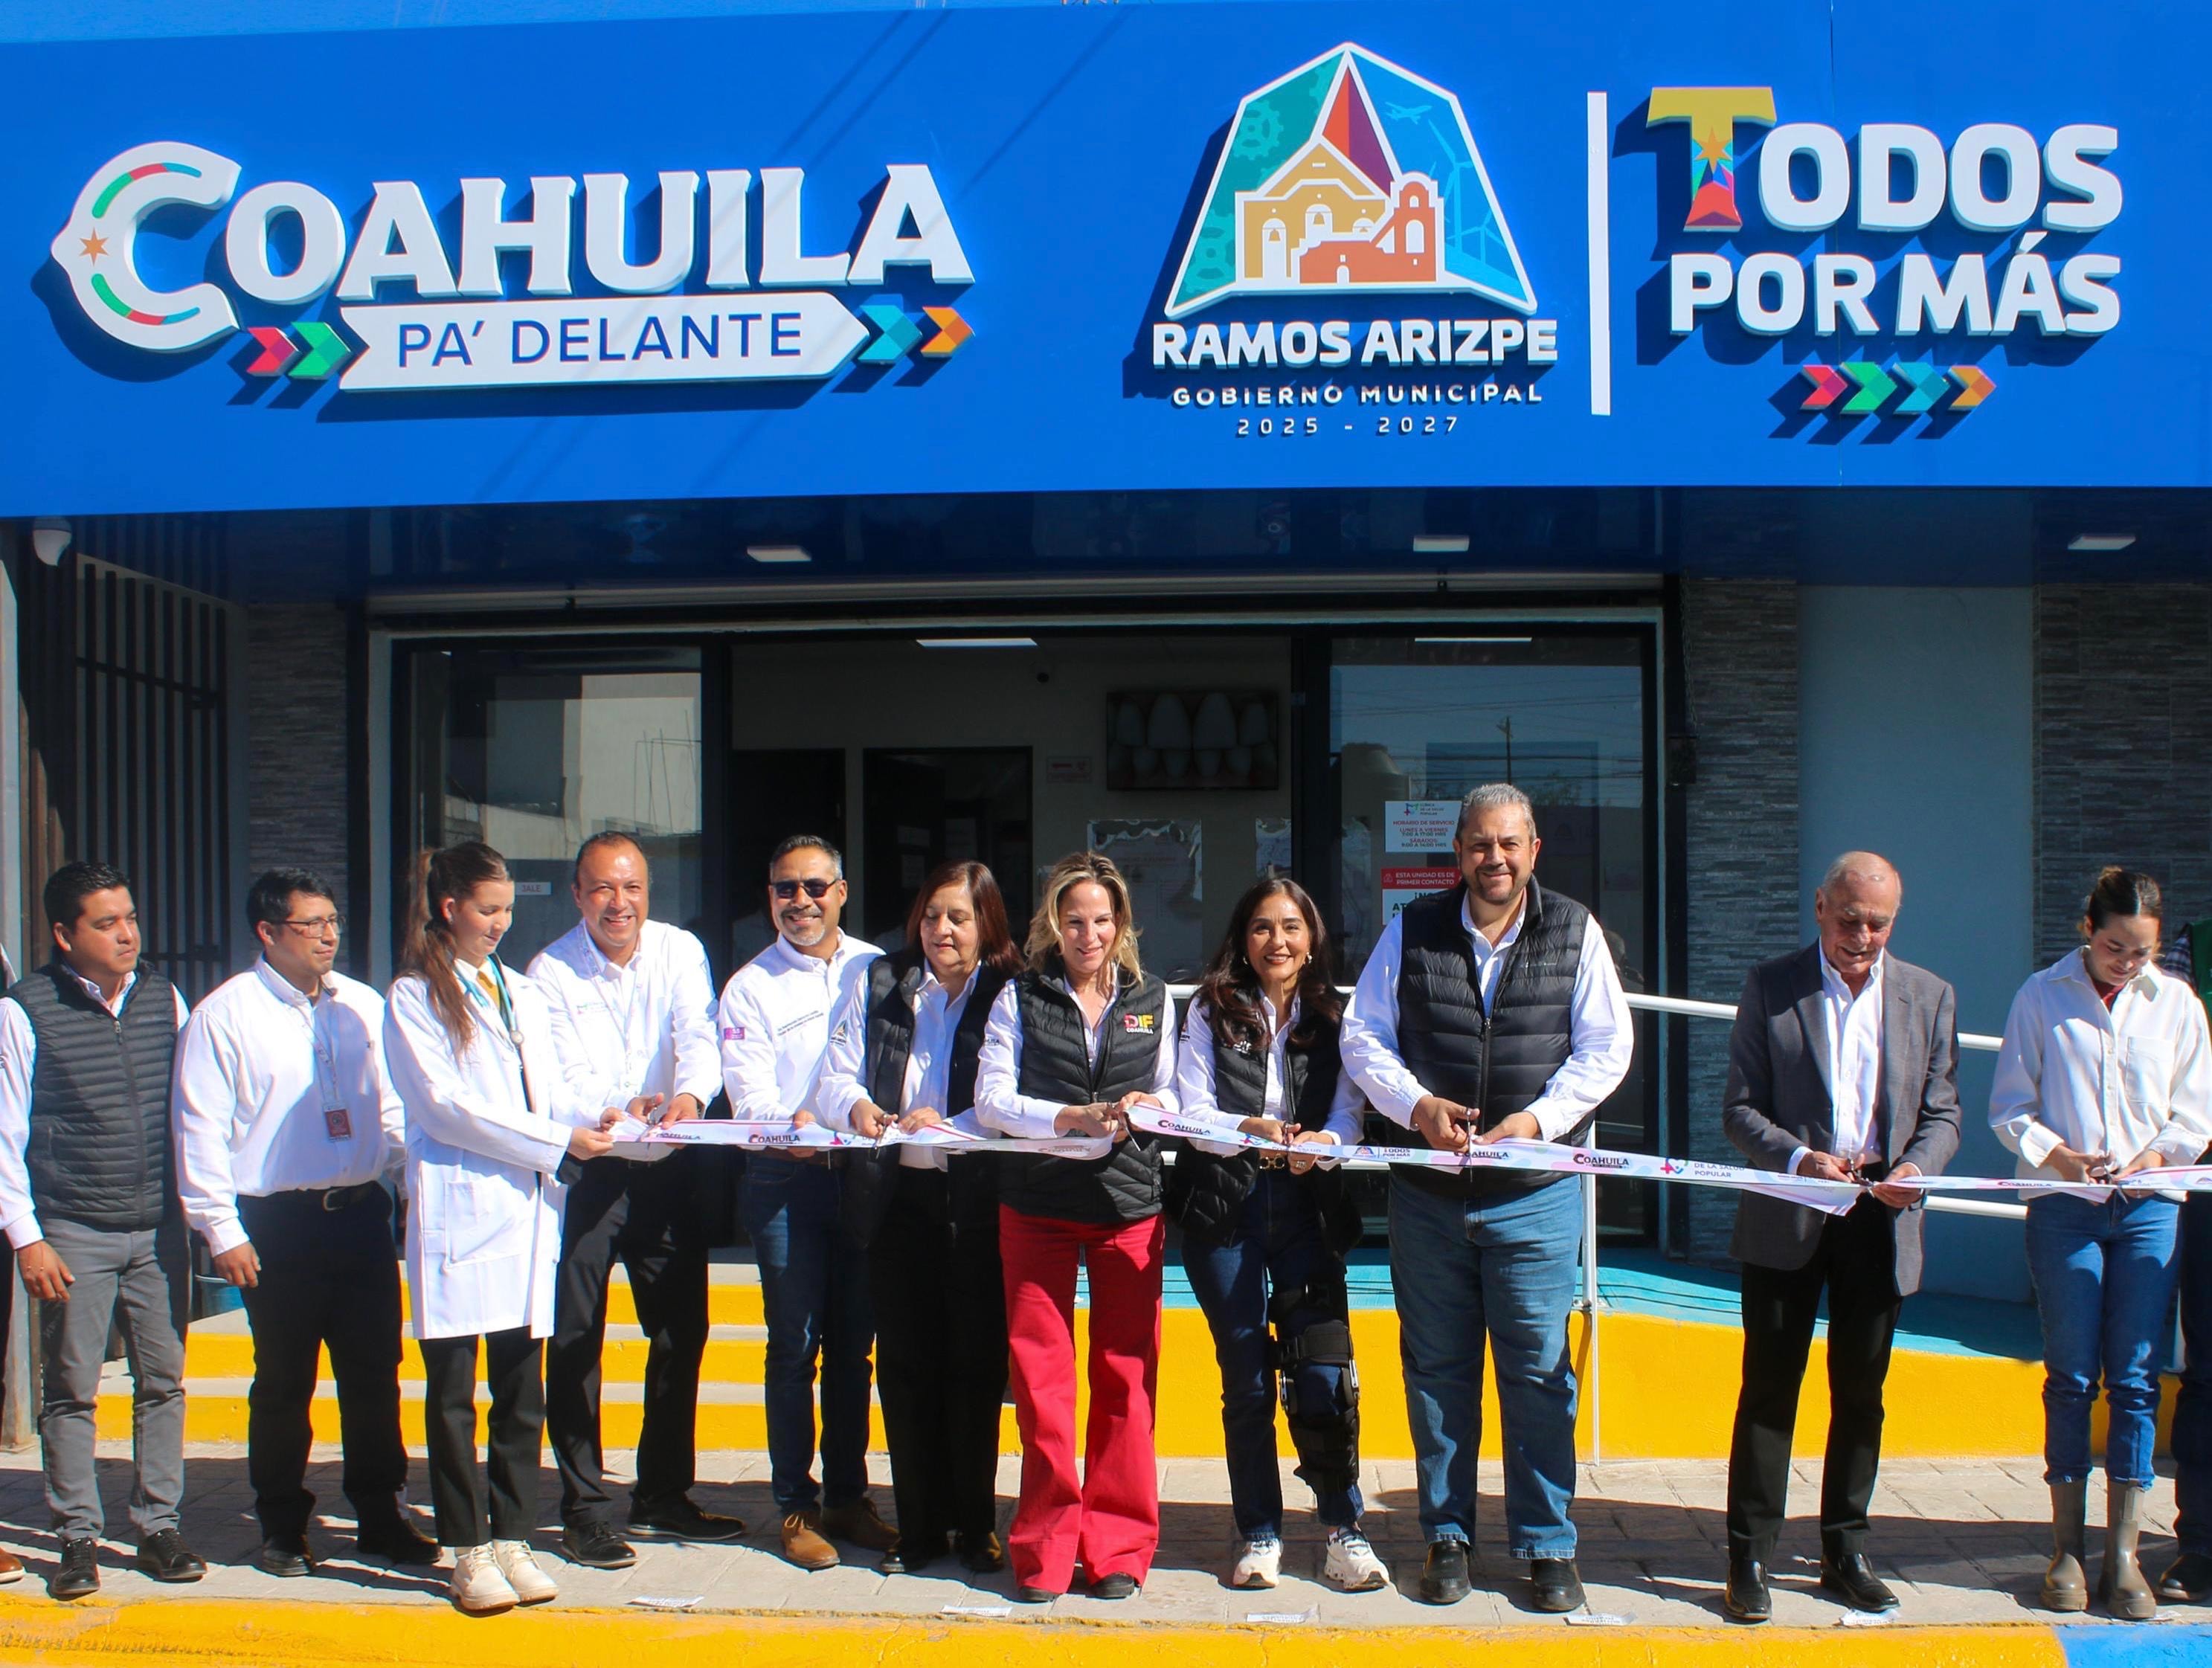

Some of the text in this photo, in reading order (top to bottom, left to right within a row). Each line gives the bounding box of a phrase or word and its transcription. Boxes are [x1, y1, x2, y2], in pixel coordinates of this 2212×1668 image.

[1646, 86, 2123, 232] TODOS
[51, 141, 975, 352] COAHUILA
[1671, 231, 2121, 337] POR MÁS
[511, 312, 802, 364] DELANTE
[1153, 319, 1558, 369] RAMOS ARIZPE
[1173, 383, 1543, 407] GOBIERNO MUNICIPAL
[1237, 416, 1319, 436] 2025
[1377, 415, 1459, 434] 2027
[1124, 1014, 1154, 1028] DIF
[1157, 1119, 1211, 1134] COAHUILA
[748, 1134, 800, 1144] COAHUILA
[1573, 1153, 1630, 1165] COAHUILA
